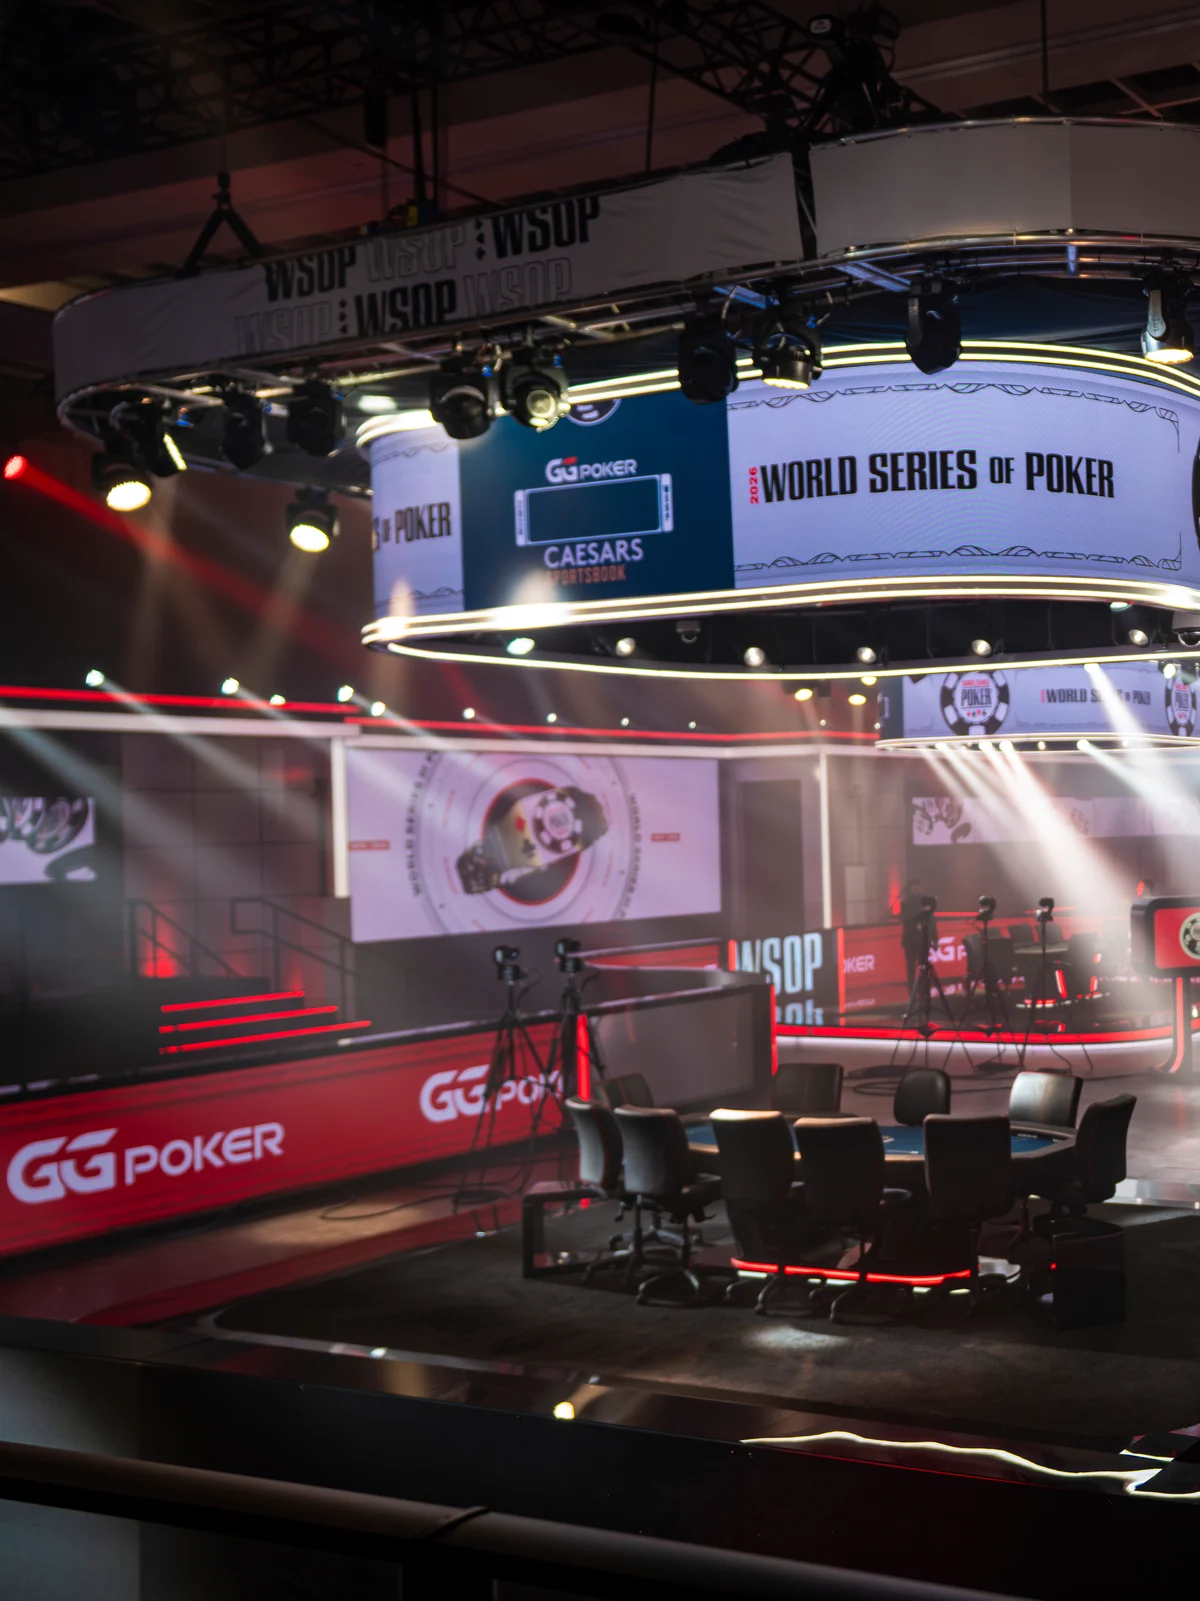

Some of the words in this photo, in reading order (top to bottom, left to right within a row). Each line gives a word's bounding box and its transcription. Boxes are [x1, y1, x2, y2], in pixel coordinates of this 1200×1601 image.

[265, 247, 357, 302] WSOP
[491, 195, 600, 259] WSOP
[354, 278, 457, 338] WSOP
[749, 466, 760, 504] 2026
[760, 455, 857, 503] WORLD
[868, 449, 977, 493] SERIES
[989, 456, 1015, 484] OF
[1025, 451, 1115, 498] POKER
[395, 502, 451, 544] POKER
[544, 538, 644, 569] CAESARS
[961, 688, 992, 706] POKER
[1046, 689, 1087, 703] WORLD
